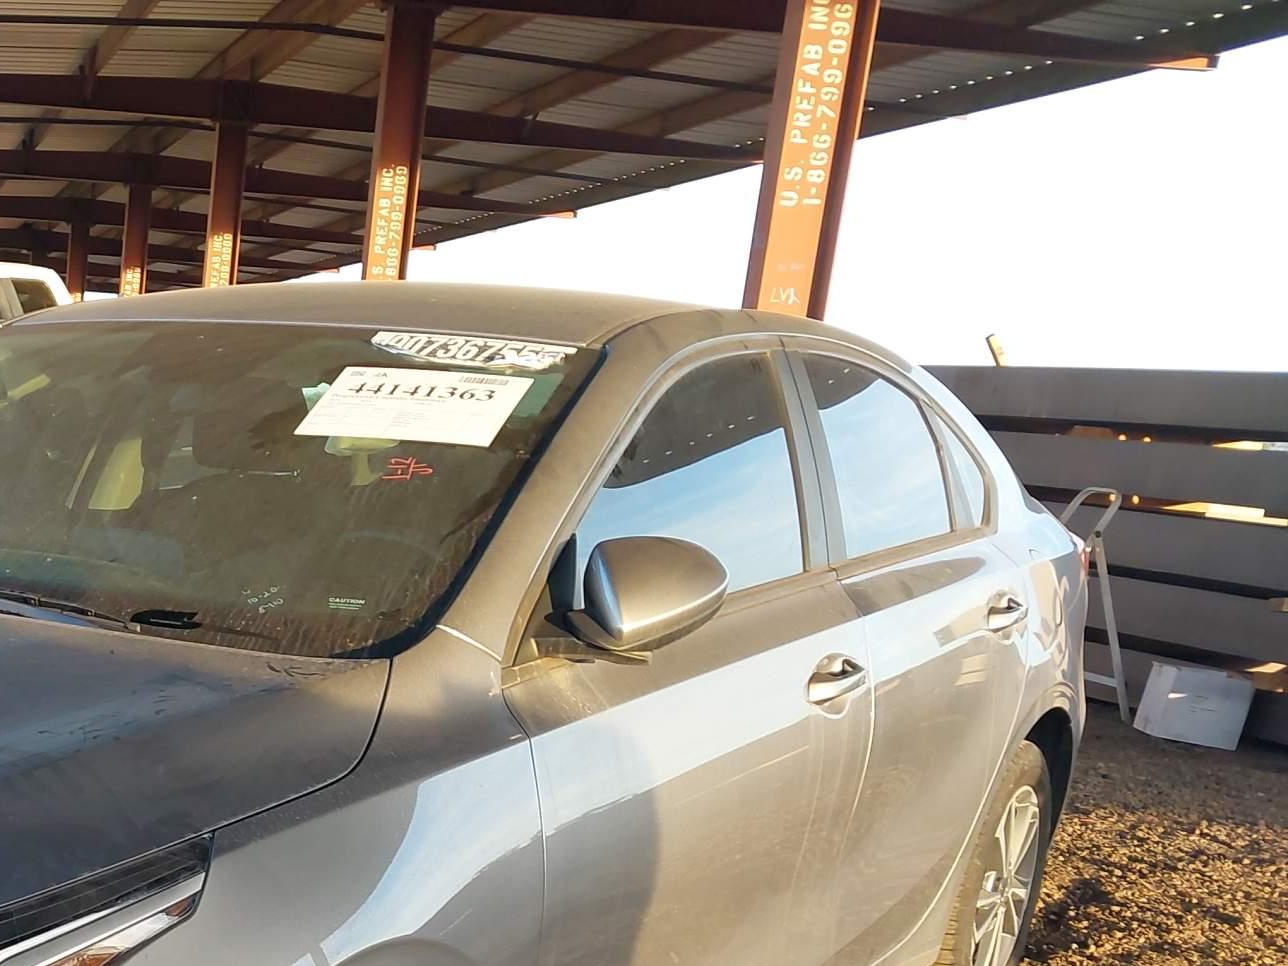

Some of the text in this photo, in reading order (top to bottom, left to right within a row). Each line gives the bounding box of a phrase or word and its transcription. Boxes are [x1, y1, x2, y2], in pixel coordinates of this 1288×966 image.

[789, 43, 823, 144] PREFAB
[374, 198, 391, 255] PREFAB
[348, 382, 497, 402] 44141363
[328, 597, 366, 605] CAUTION
